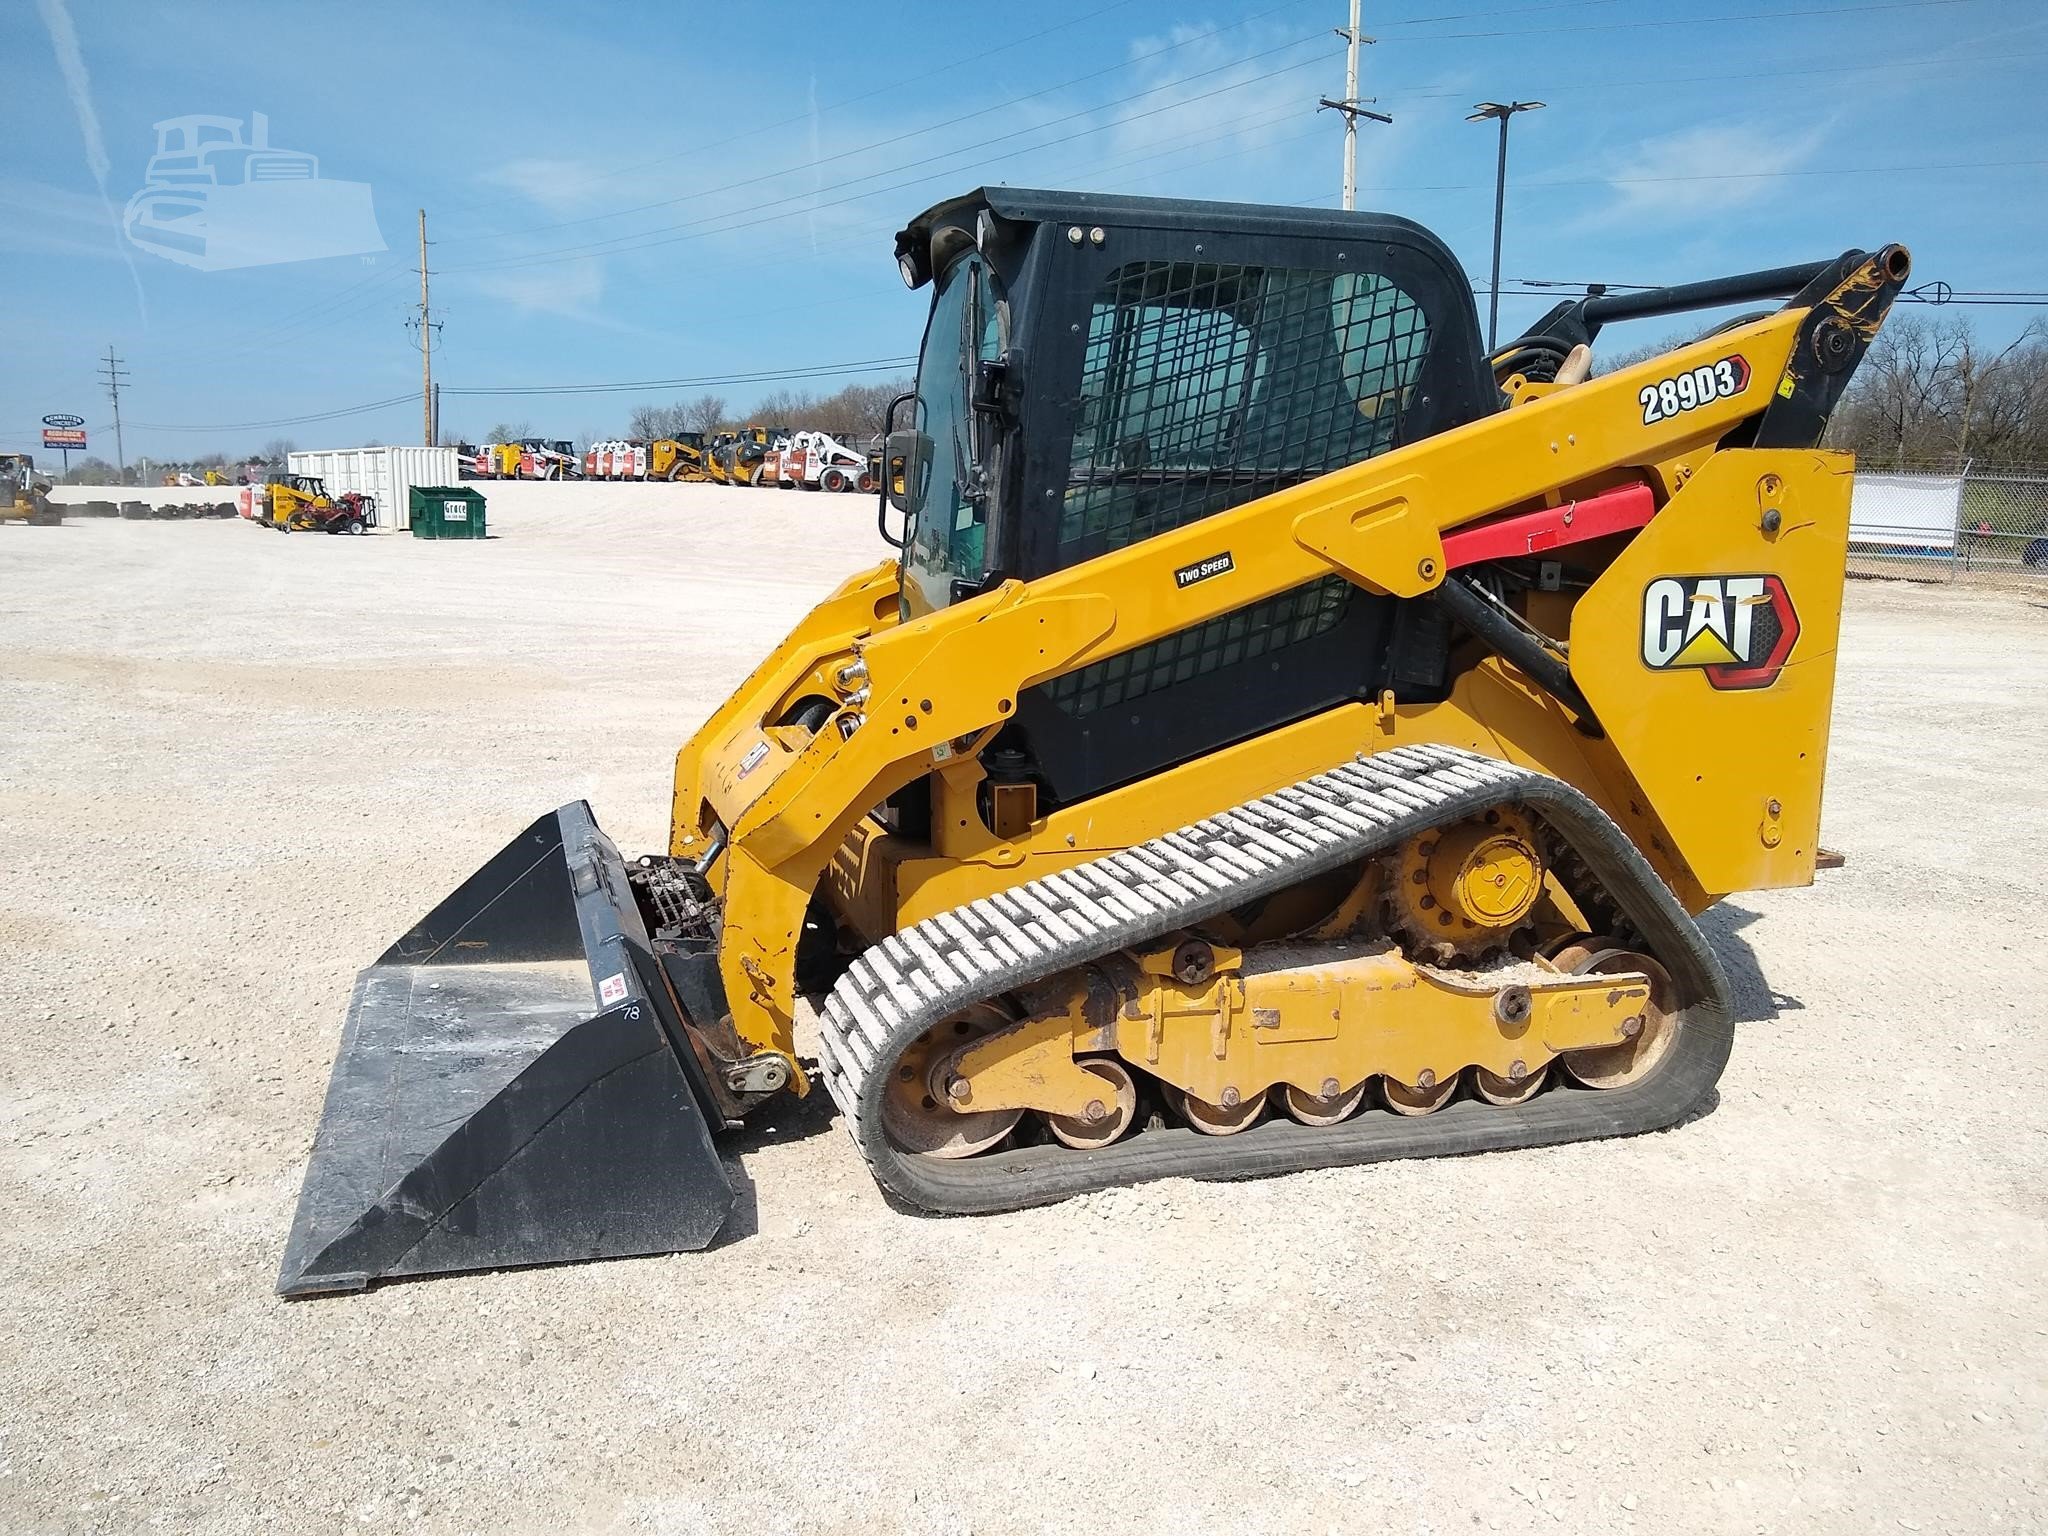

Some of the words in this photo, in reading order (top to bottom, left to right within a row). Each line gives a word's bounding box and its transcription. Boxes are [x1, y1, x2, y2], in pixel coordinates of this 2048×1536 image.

[1640, 360, 1735, 425] 289D3
[445, 502, 466, 514] Grace
[1178, 568, 1200, 584] TWO
[1200, 557, 1229, 576] SPEED
[1643, 578, 1764, 667] CAT
[621, 1006, 641, 1020] 78
